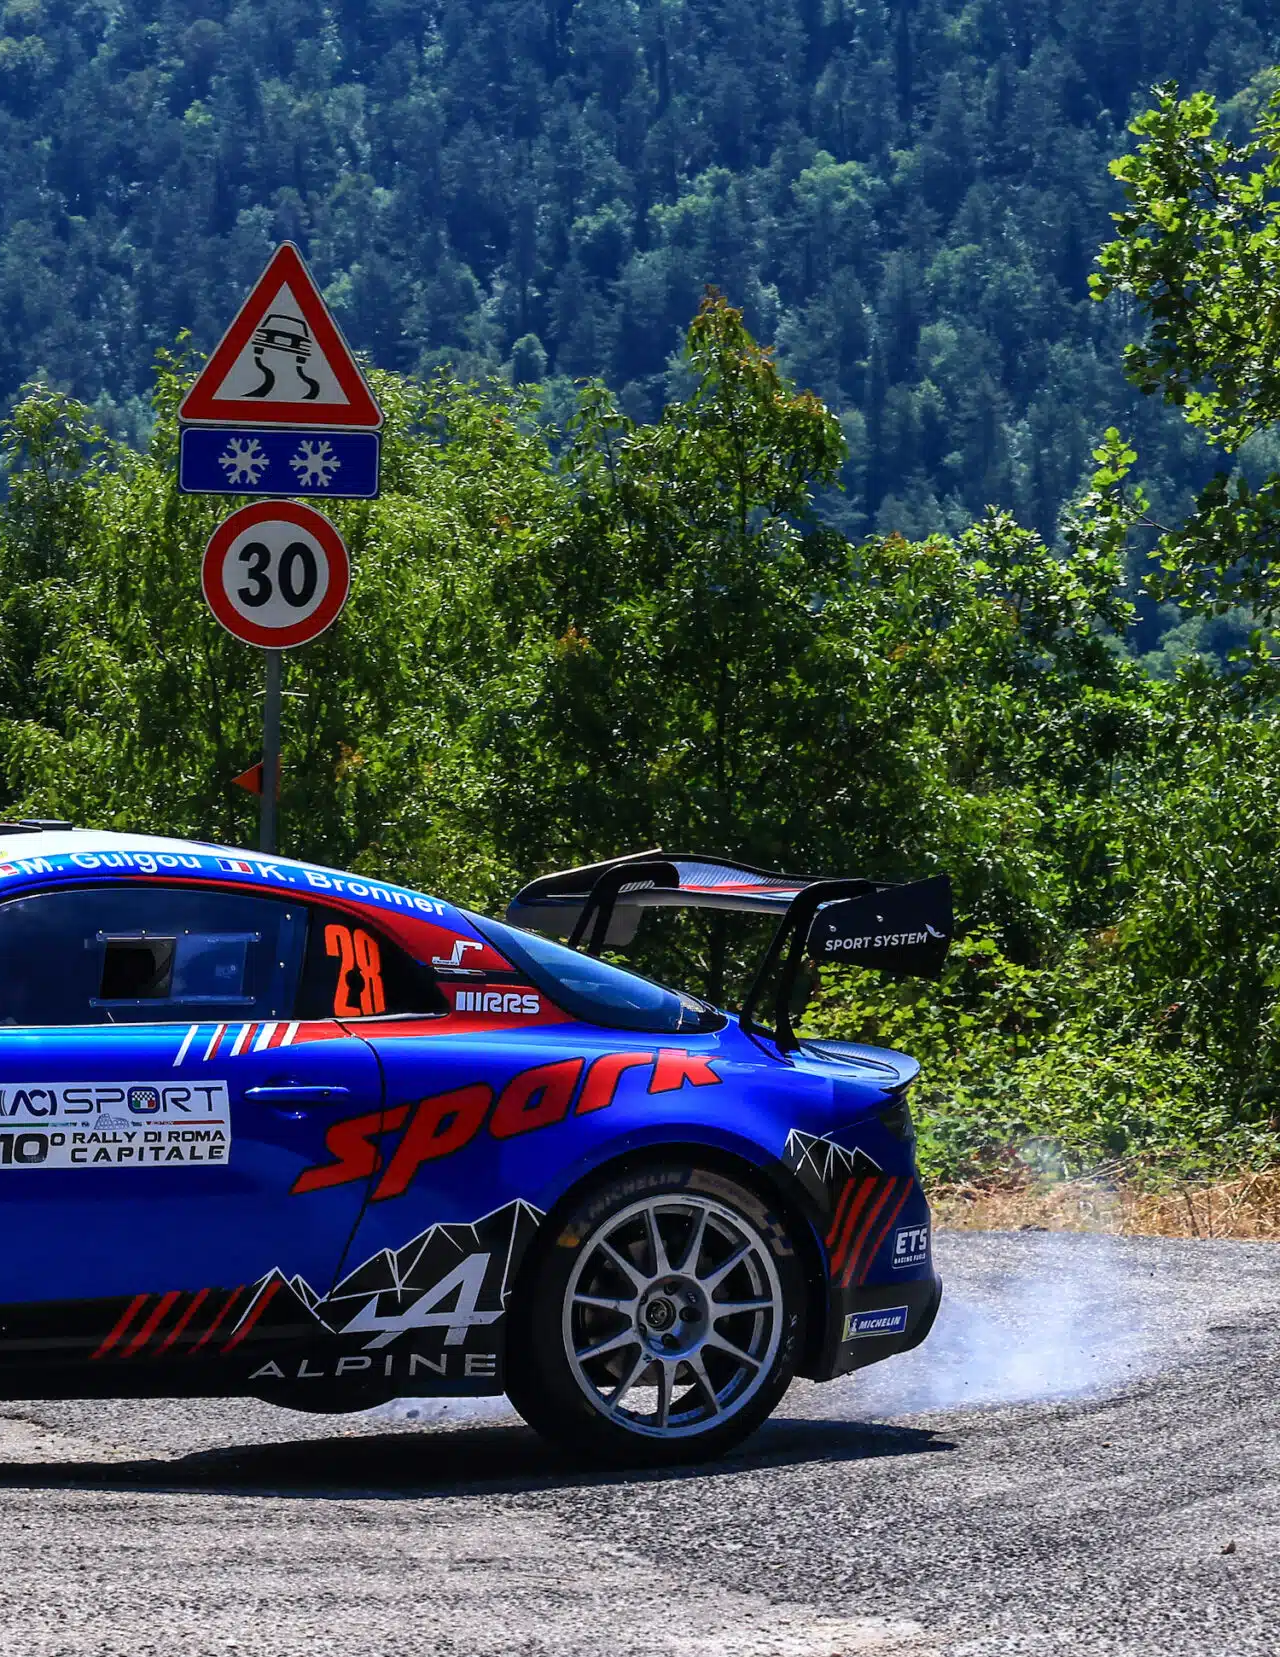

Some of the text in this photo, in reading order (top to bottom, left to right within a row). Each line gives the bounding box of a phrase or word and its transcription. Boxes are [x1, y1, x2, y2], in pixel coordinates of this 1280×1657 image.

[237, 541, 318, 608] 30
[18, 850, 201, 876] M. Guigou
[254, 862, 447, 916] K. Bronner
[825, 931, 927, 951] SPORT SYSTEM
[324, 924, 386, 1017] 28
[63, 1086, 223, 1115] SPORT
[72, 1131, 137, 1144] RALLY
[143, 1131, 163, 1143] DI
[168, 1129, 226, 1143] ROMA
[70, 1145, 226, 1163] CAPITALE
[895, 1227, 928, 1255] ETS
[858, 1315, 901, 1330] MICHELIN
[248, 1353, 497, 1379] ALPINE
